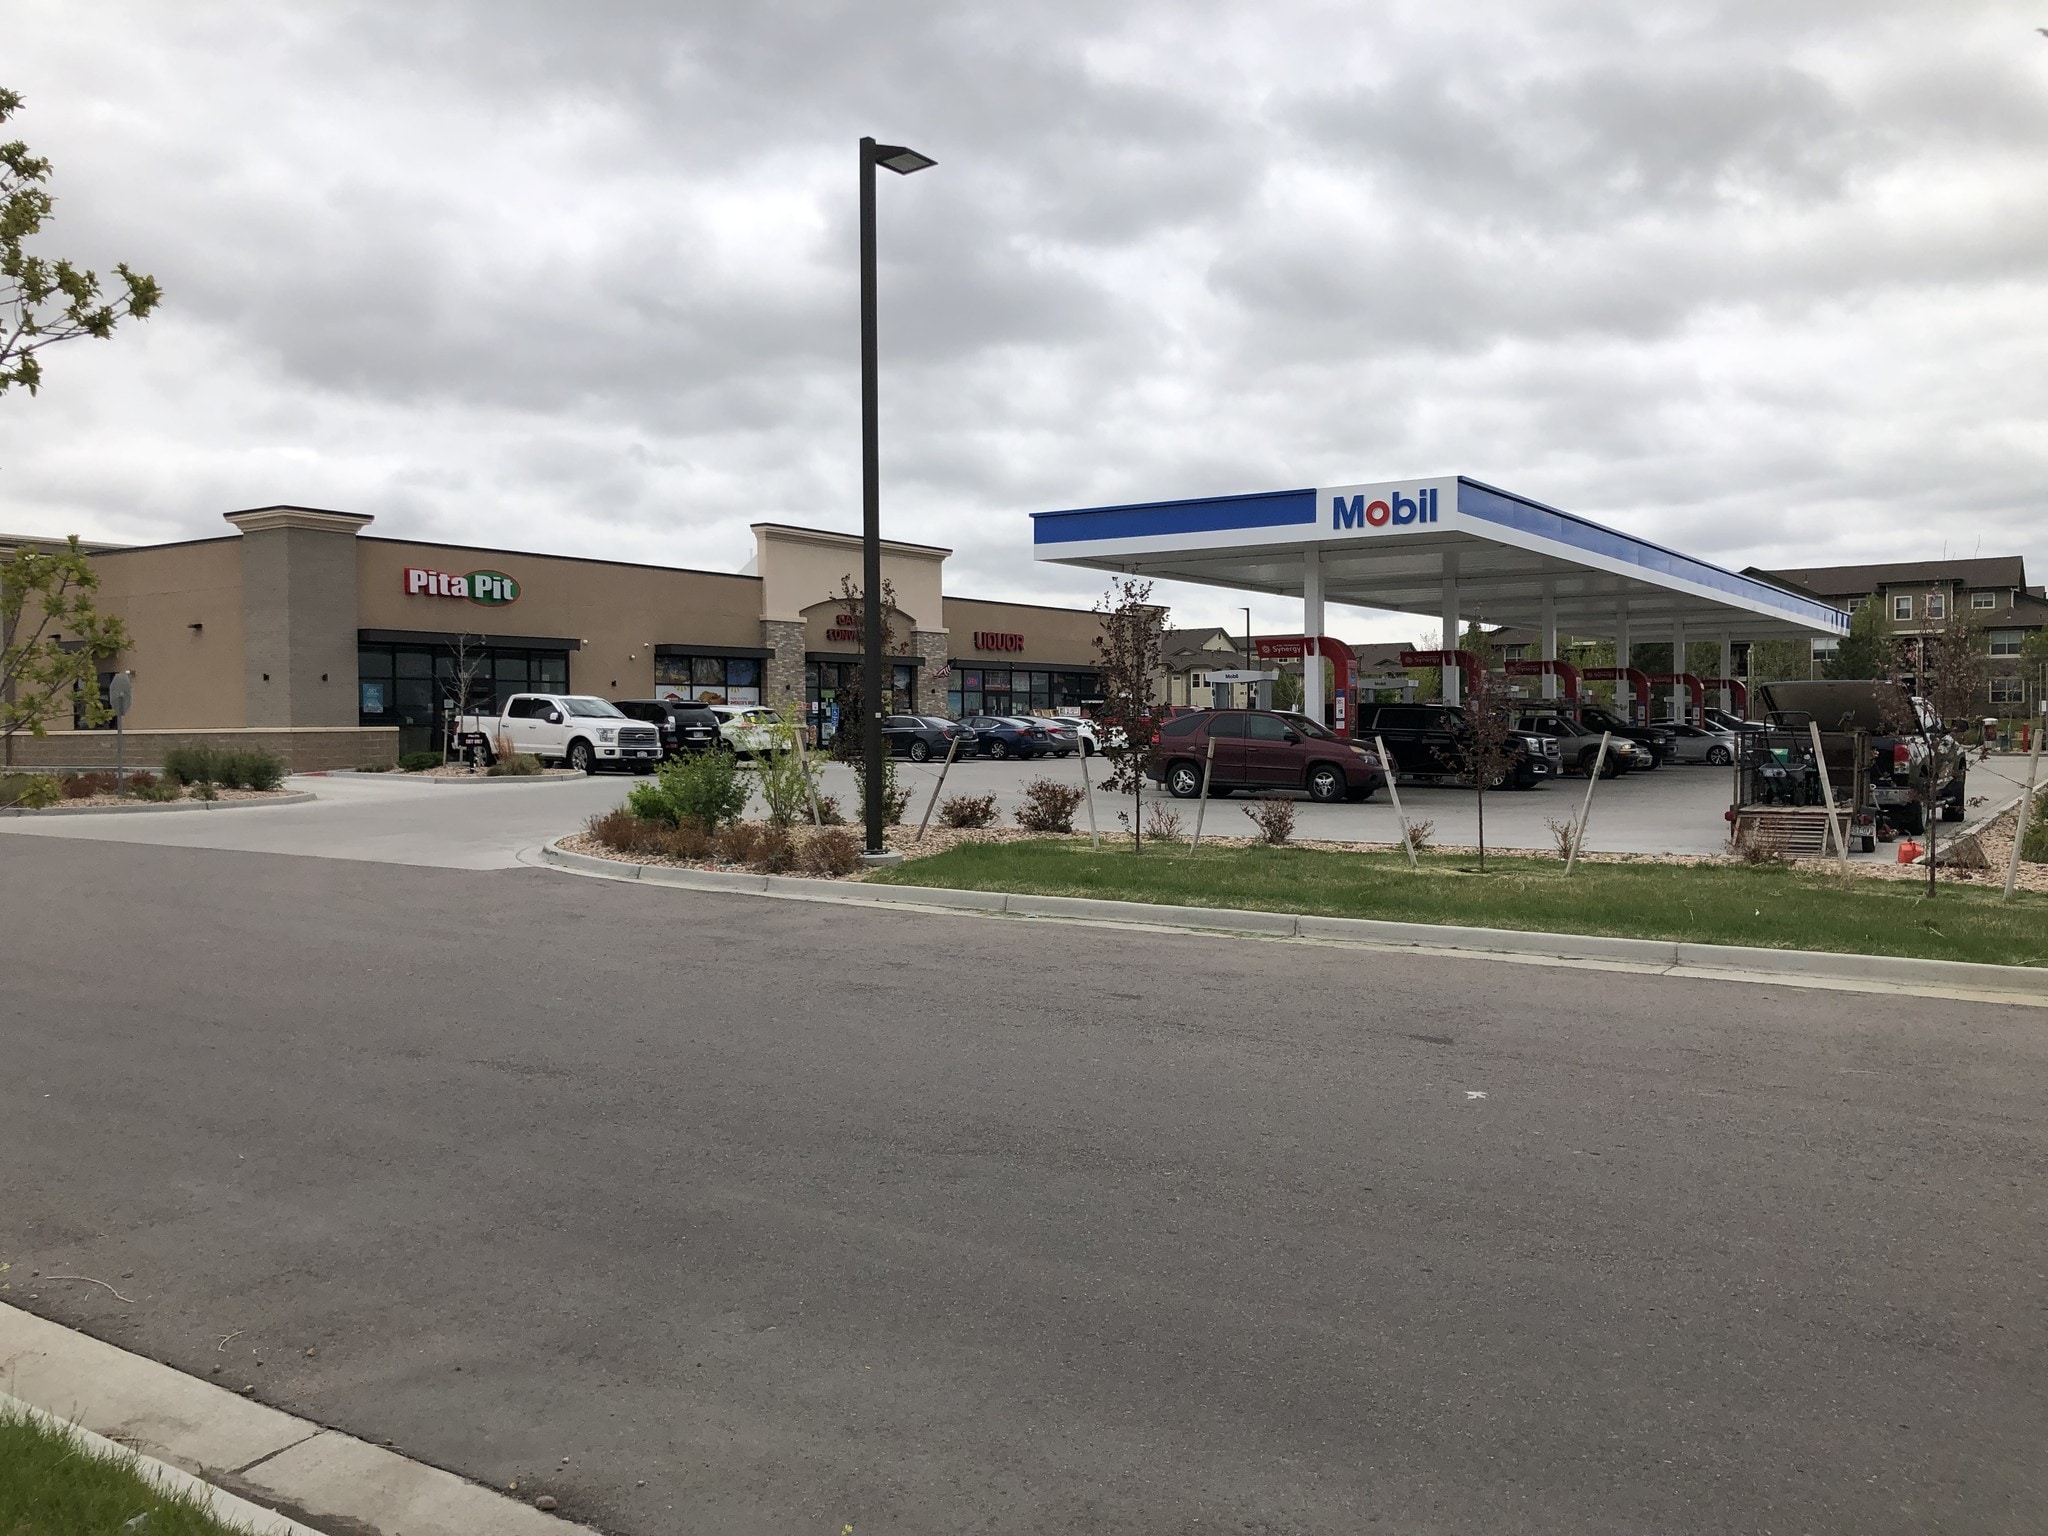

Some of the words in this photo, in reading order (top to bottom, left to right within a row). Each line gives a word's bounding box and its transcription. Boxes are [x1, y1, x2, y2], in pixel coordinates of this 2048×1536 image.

[1333, 488, 1438, 530] Mobil
[408, 568, 469, 597] Pita
[474, 574, 514, 600] Pit
[974, 631, 1025, 651] LIQUOR
[1272, 645, 1301, 654] Synergy
